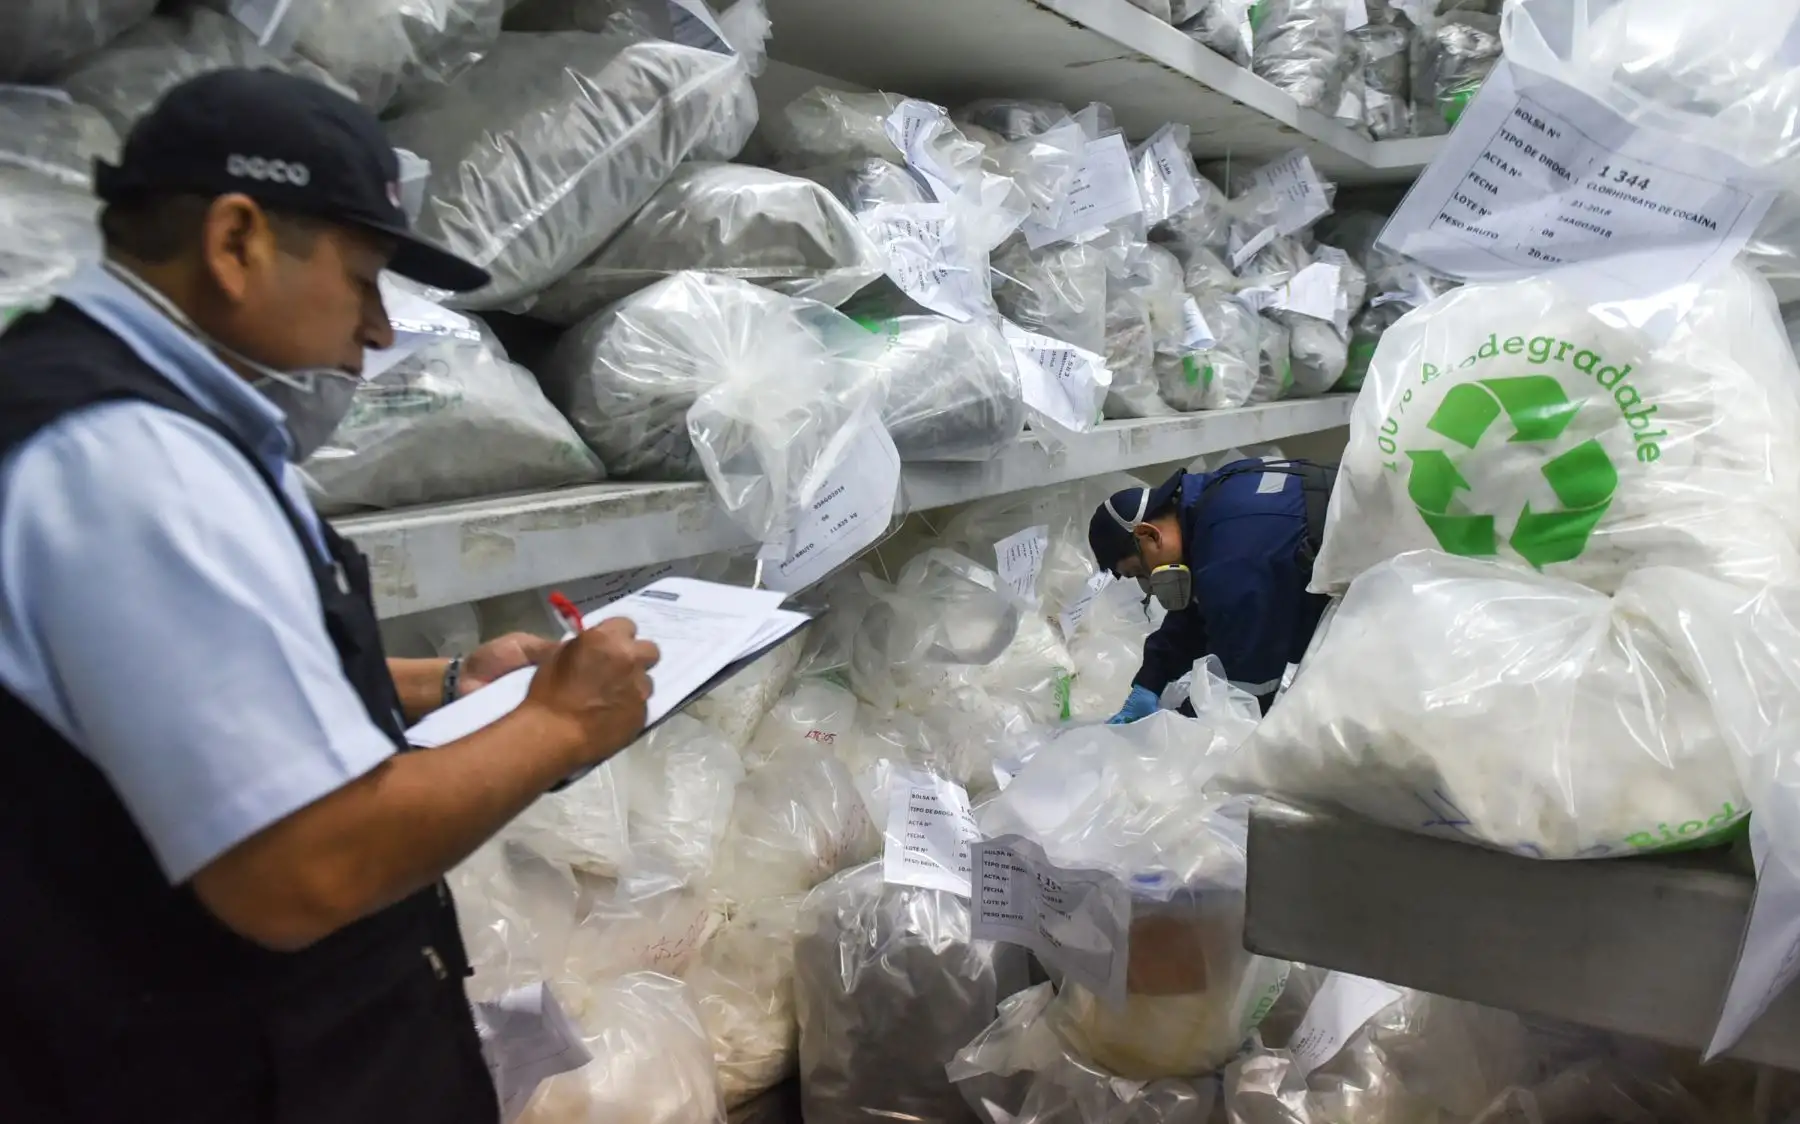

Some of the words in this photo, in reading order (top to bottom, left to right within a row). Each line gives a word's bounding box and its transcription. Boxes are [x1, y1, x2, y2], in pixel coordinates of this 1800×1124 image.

[1514, 107, 1545, 131] BOLSA
[1598, 165, 1610, 178] 1
[1613, 169, 1650, 190] 344
[1482, 151, 1507, 171] ACTA
[1500, 129, 1523, 148] TIPO
[1524, 144, 1539, 158] DE
[1539, 154, 1571, 180] DROGA
[1586, 182, 1656, 209] CLORHIDRATO
[1658, 204, 1672, 216] DE
[1468, 171, 1498, 195] FECHA
[1454, 192, 1477, 211] LOTE
[1439, 212, 1464, 228] PESO
[1466, 225, 1499, 239] BRUTO
[1420, 333, 1668, 464] Bodegradable
[911, 793, 930, 801] BOLSA
[984, 860, 1000, 869] TIPO
[984, 873, 1000, 881] ACTA
[983, 886, 1004, 894] FECHA
